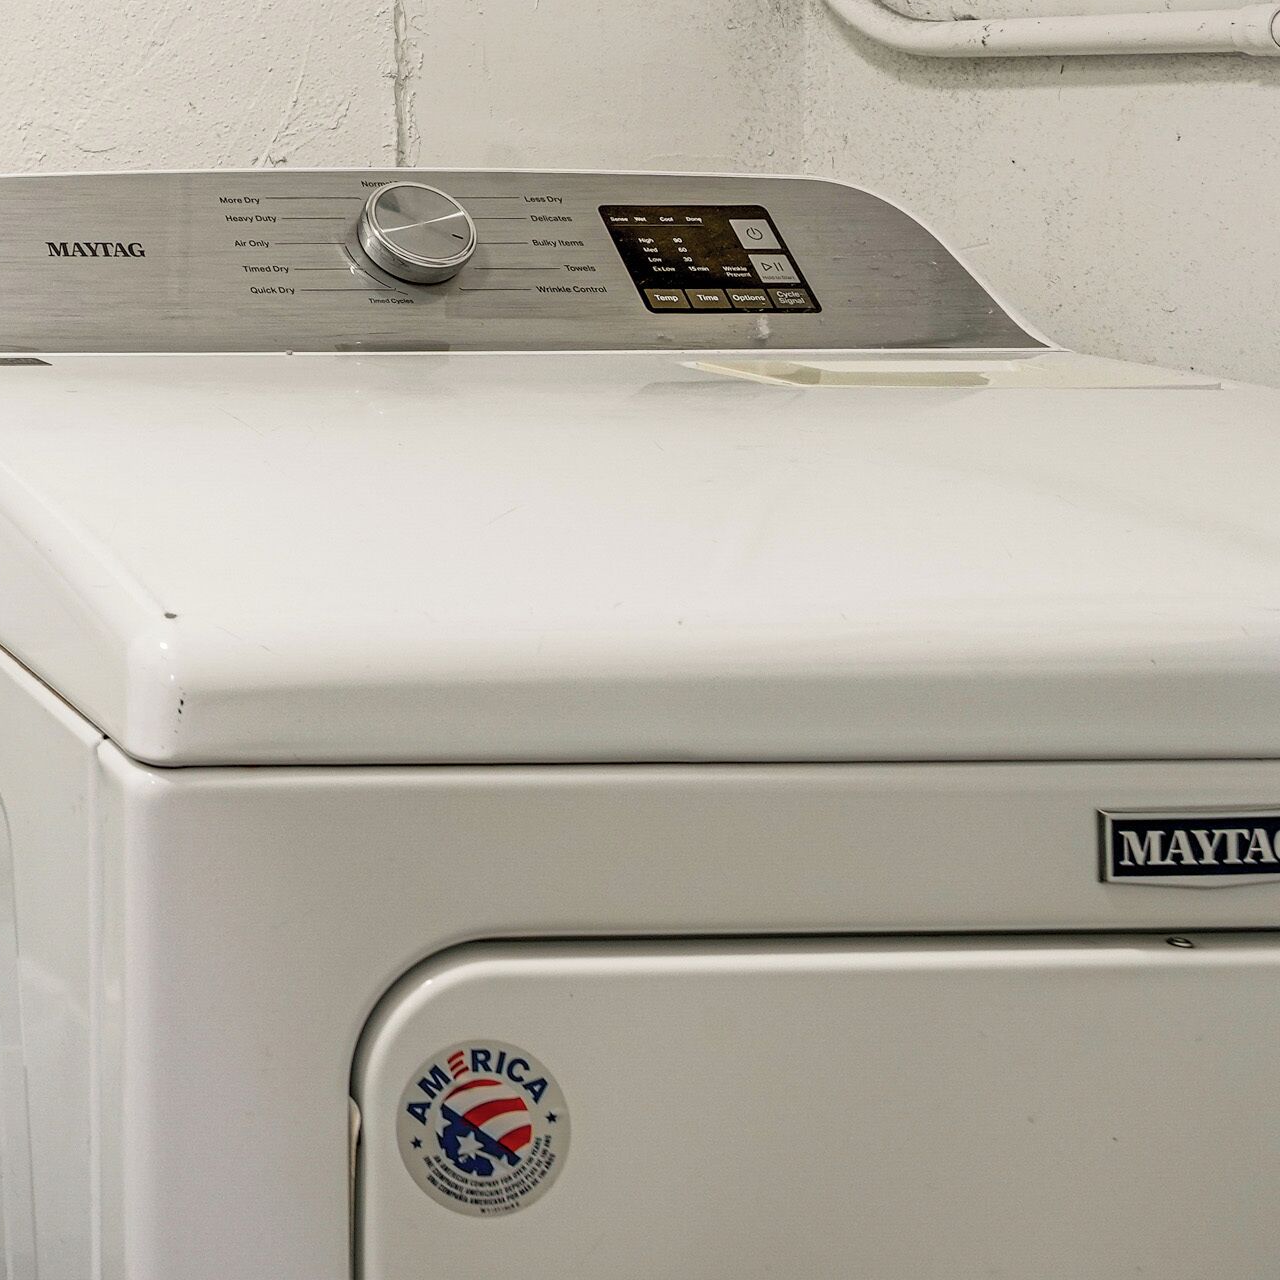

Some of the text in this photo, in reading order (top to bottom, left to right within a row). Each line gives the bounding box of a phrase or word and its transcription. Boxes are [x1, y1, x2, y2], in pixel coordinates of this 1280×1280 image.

[244, 197, 260, 205] Dry
[546, 196, 563, 204] Dry
[225, 215, 277, 223] Heavy Duty
[248, 240, 270, 248] Only
[532, 239, 584, 248] Bulky Items
[45, 241, 146, 258] MAYTAG
[242, 265, 289, 274] Timed Dry
[564, 264, 596, 272] Towels
[250, 286, 295, 295] Quick Dry
[536, 285, 608, 293] Wrinkle Control
[654, 294, 679, 302] Temp
[776, 290, 800, 298] Cycle
[732, 294, 766, 303] Options
[779, 297, 805, 305] Signal
[1118, 828, 1280, 866] MAYTA
[406, 1050, 548, 1126] AMERICA
